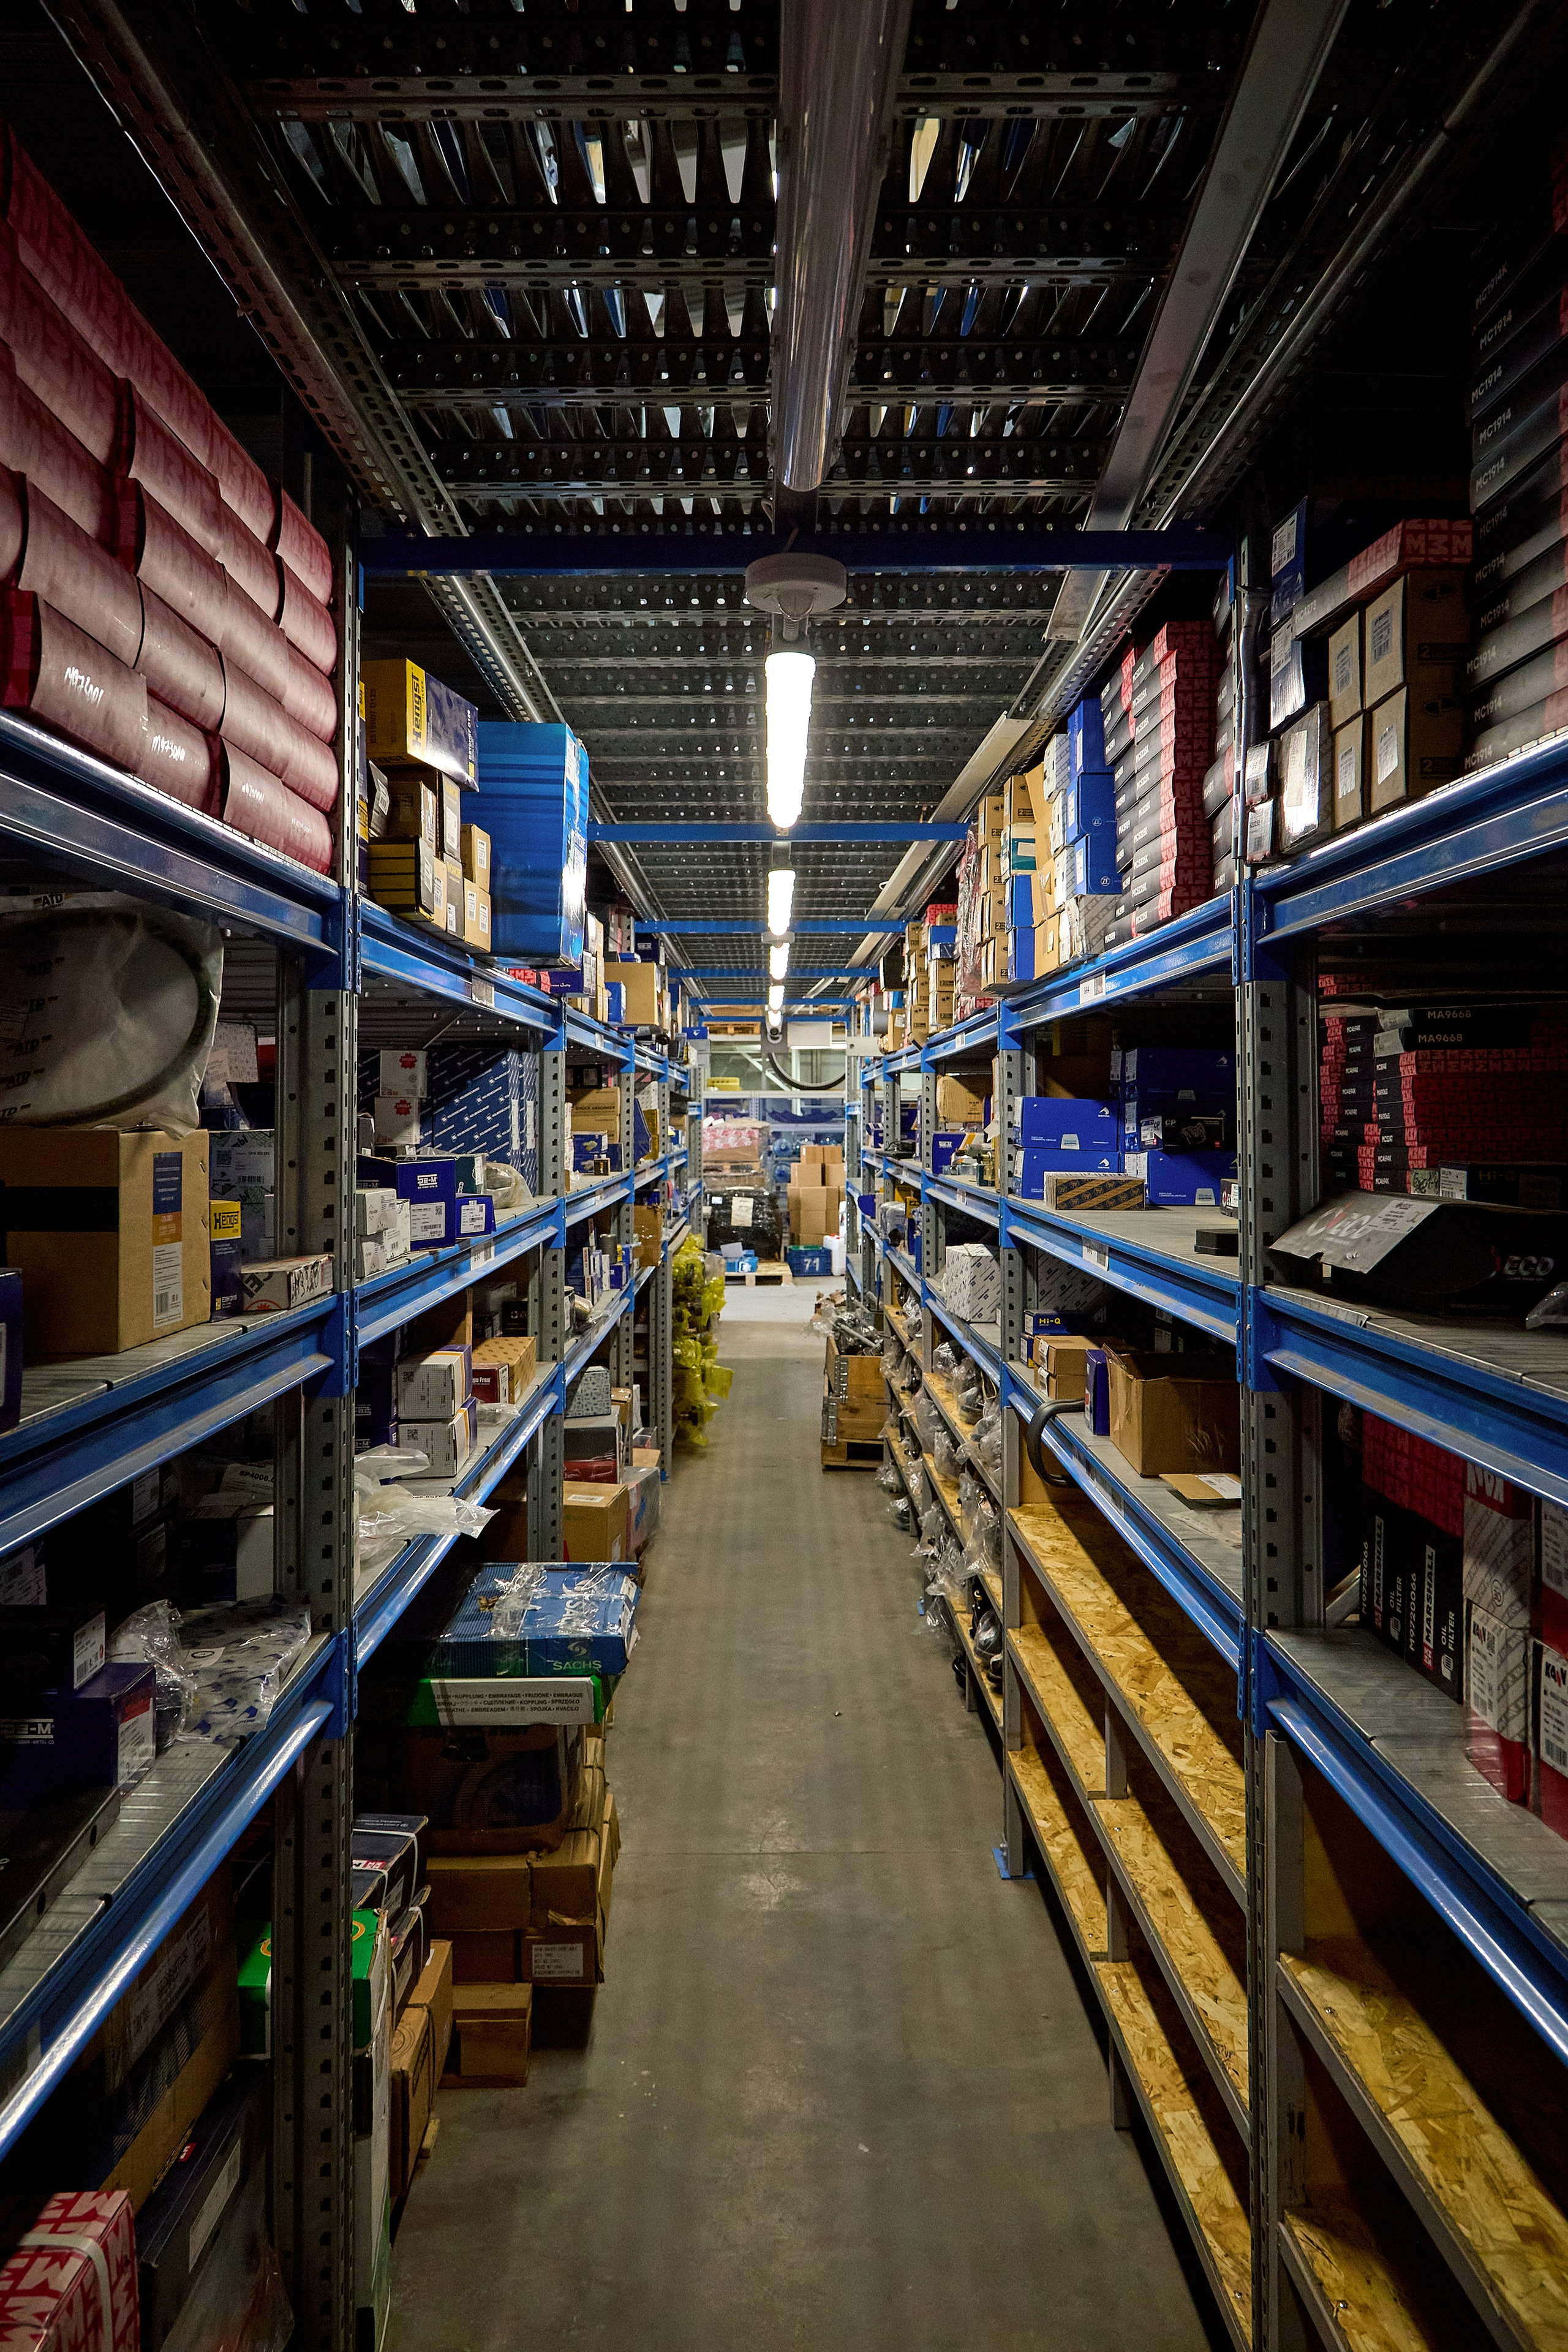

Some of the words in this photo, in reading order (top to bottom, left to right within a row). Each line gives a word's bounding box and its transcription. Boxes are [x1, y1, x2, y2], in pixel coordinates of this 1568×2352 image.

[1480, 309, 1513, 350] MC1914
[1471, 365, 1502, 404] MC1914
[1479, 407, 1512, 445] MC1914
[1476, 456, 1504, 491] MC1914
[1479, 506, 1507, 539] MC1914
[1475, 552, 1506, 584] MC1914
[1480, 598, 1510, 629] MC1914
[1466, 646, 1496, 674] MC1914
[412, 672, 422, 747] Hengst
[1474, 695, 1502, 723] MC1914
[1464, 744, 1493, 770] MC1914
[42, 894, 63, 907] ATD
[1427, 1011, 1472, 1019] MA9668
[1418, 1033, 1463, 1042] MA9668
[804, 1257, 820, 1272] 71
[1502, 1256, 1555, 1276] ECD
[1360, 1540, 1369, 1615] M9720066
[1374, 1518, 1384, 1611] MARSHALL
[1409, 1571, 1417, 1653] M9720066
[1425, 1548, 1436, 1648] MARSHALL
[552, 1660, 602, 1671] SACHS
